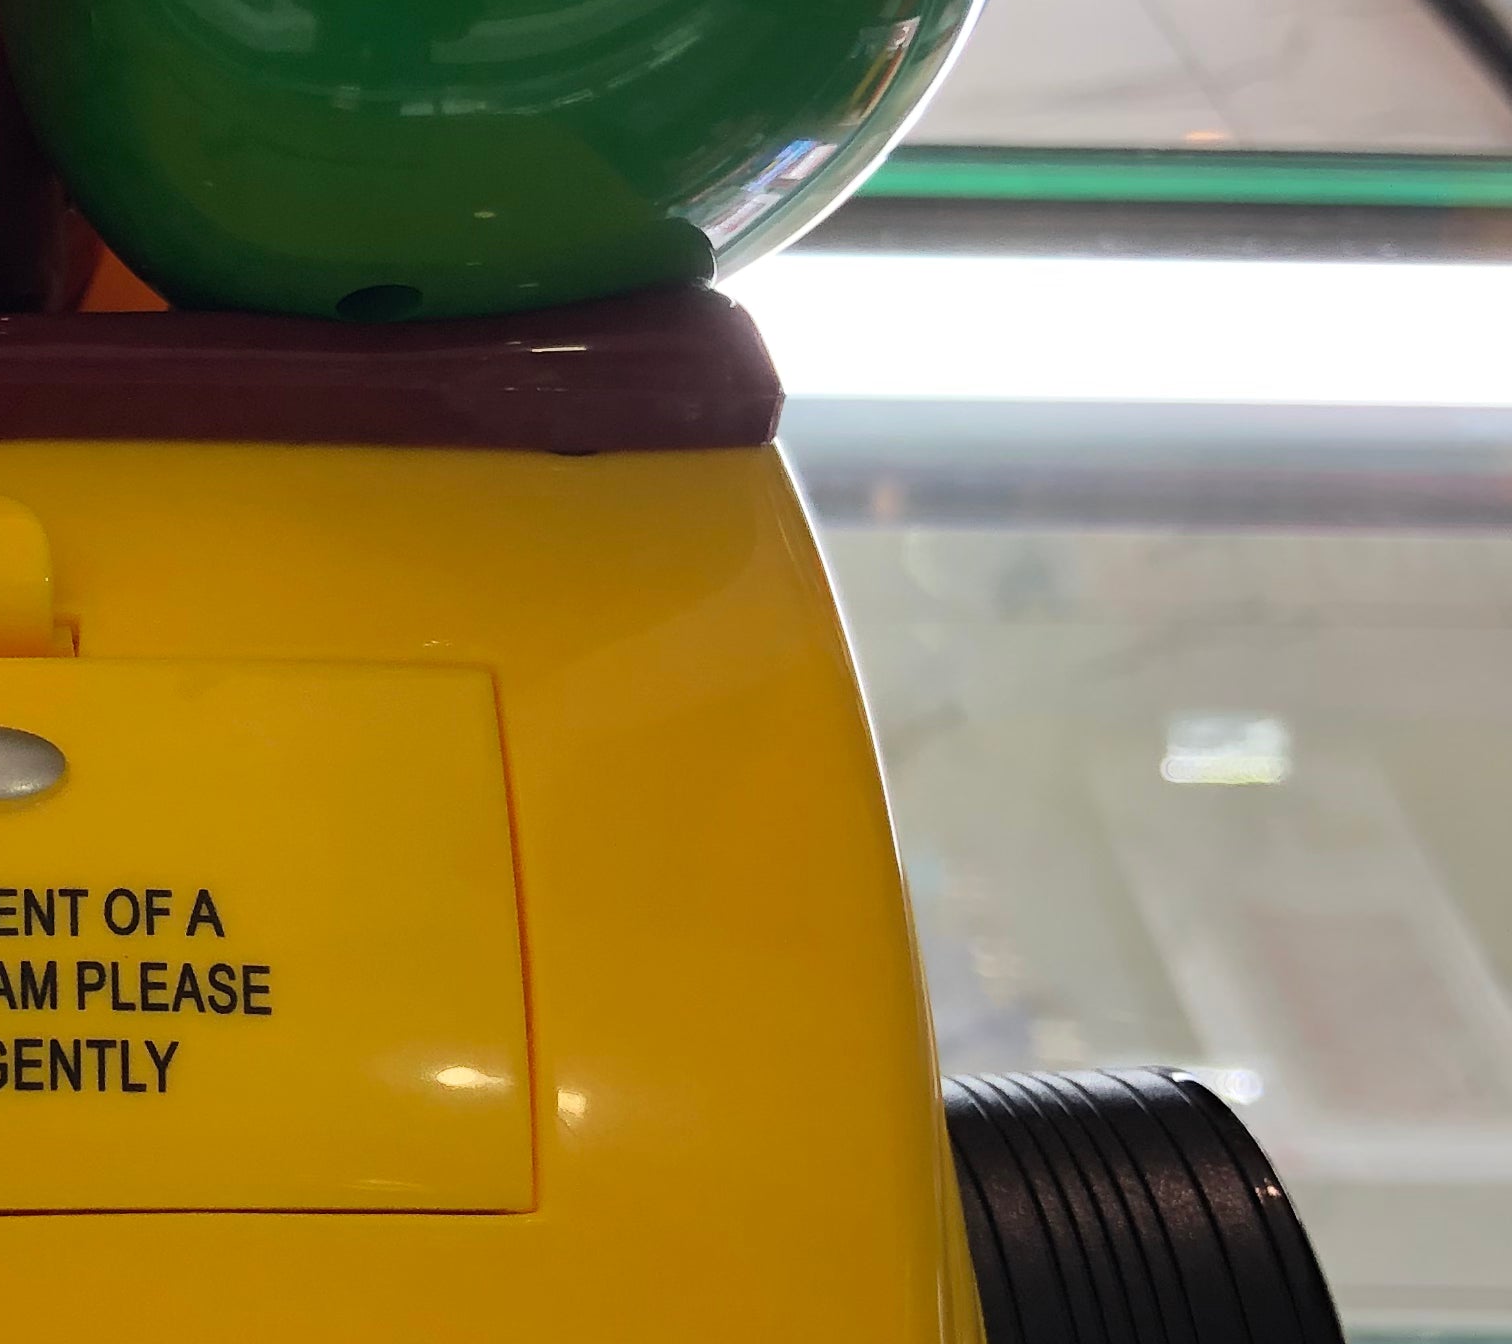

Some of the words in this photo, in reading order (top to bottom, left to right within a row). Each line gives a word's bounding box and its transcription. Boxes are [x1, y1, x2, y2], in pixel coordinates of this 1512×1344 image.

[104, 888, 172, 935] OF
[186, 889, 225, 937] A
[76, 960, 272, 1015] PLEASE
